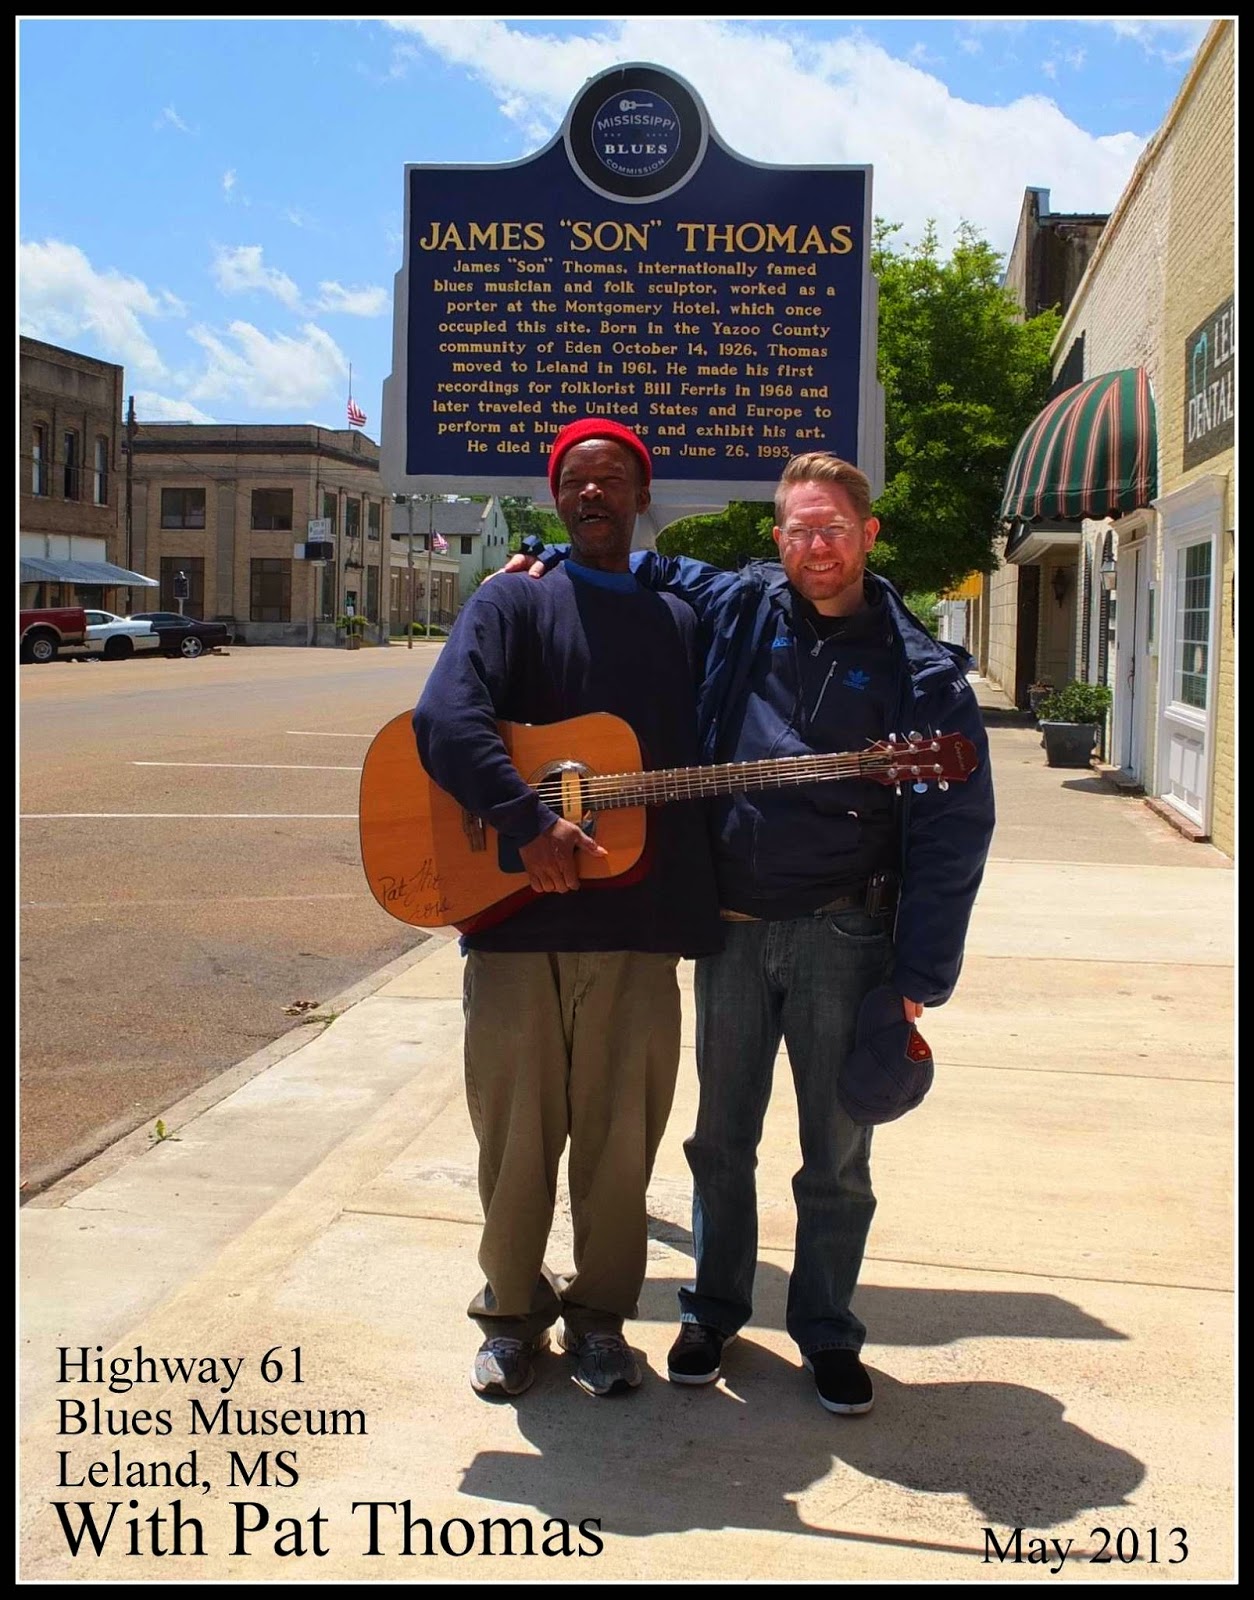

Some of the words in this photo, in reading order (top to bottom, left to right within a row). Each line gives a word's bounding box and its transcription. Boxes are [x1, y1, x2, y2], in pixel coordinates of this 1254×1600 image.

[597, 114, 676, 130] MISSISSIPPI
[604, 144, 668, 154] BLUES
[606, 158, 665, 174] COMMISSION
[420, 222, 545, 251] JAMES
[560, 219, 662, 251] “SON”
[676, 222, 853, 254] THOMAS
[454, 260, 500, 273] James
[638, 261, 758, 278] internationally
[767, 262, 817, 276] famed
[434, 279, 474, 292] blues
[484, 279, 552, 293] musician
[564, 280, 593, 293] and
[604, 280, 635, 293] folk
[730, 282, 787, 295] worked
[799, 286, 816, 296] as
[826, 286, 835, 296] a
[446, 300, 498, 314] porter
[507, 300, 523, 312] at
[531, 300, 557, 313] the
[565, 300, 662, 316] Montgomery
[730, 302, 775, 315] which
[785, 306, 822, 316] once
[438, 320, 507, 335] occupied
[516, 320, 546, 333] this
[555, 321, 590, 333] site.
[600, 320, 637, 334] Born
[648, 321, 663, 334] in
[674, 322, 700, 335] the
[712, 322, 761, 335] Yazoo
[772, 323, 830, 338] County
[439, 341, 526, 355] community
[536, 341, 555, 353] of
[565, 340, 602, 354] Eden
[612, 341, 678, 355] October
[767, 343, 828, 358] Thomas
[452, 360, 502, 372] moved
[511, 360, 528, 372] to
[536, 360, 588, 374] Leland
[598, 361, 613, 374] in
[622, 361, 657, 374] 1961.
[666, 362, 687, 375] He
[697, 363, 738, 376] made
[746, 363, 769, 376] his
[777, 364, 813, 377] first
[437, 380, 519, 396] recordings
[528, 381, 552, 393] for
[561, 381, 635, 395] folklorist
[644, 382, 671, 395] Bill
[681, 382, 726, 396] Ferris
[735, 384, 751, 396] in
[760, 384, 793, 397] 1968
[800, 385, 828, 398] and
[433, 400, 469, 412] later
[477, 400, 542, 413] traveled
[551, 401, 577, 414] the
[585, 401, 638, 415] United
[649, 402, 698, 416] States
[708, 404, 736, 416] and
[747, 404, 802, 420] Europe
[814, 406, 832, 418] to
[1187, 370, 1235, 444] DENTAL
[438, 420, 501, 435] perform
[509, 421, 525, 433] at
[534, 421, 568, 434] blue
[657, 423, 686, 436] and
[696, 424, 754, 437] exhibit
[763, 424, 786, 437] his
[795, 426, 826, 438] art.
[467, 439, 488, 452] He
[496, 440, 530, 453] died
[539, 441, 555, 454] in
[652, 446, 671, 456] on
[679, 444, 716, 457] June
[378, 876, 408, 909] Pat
